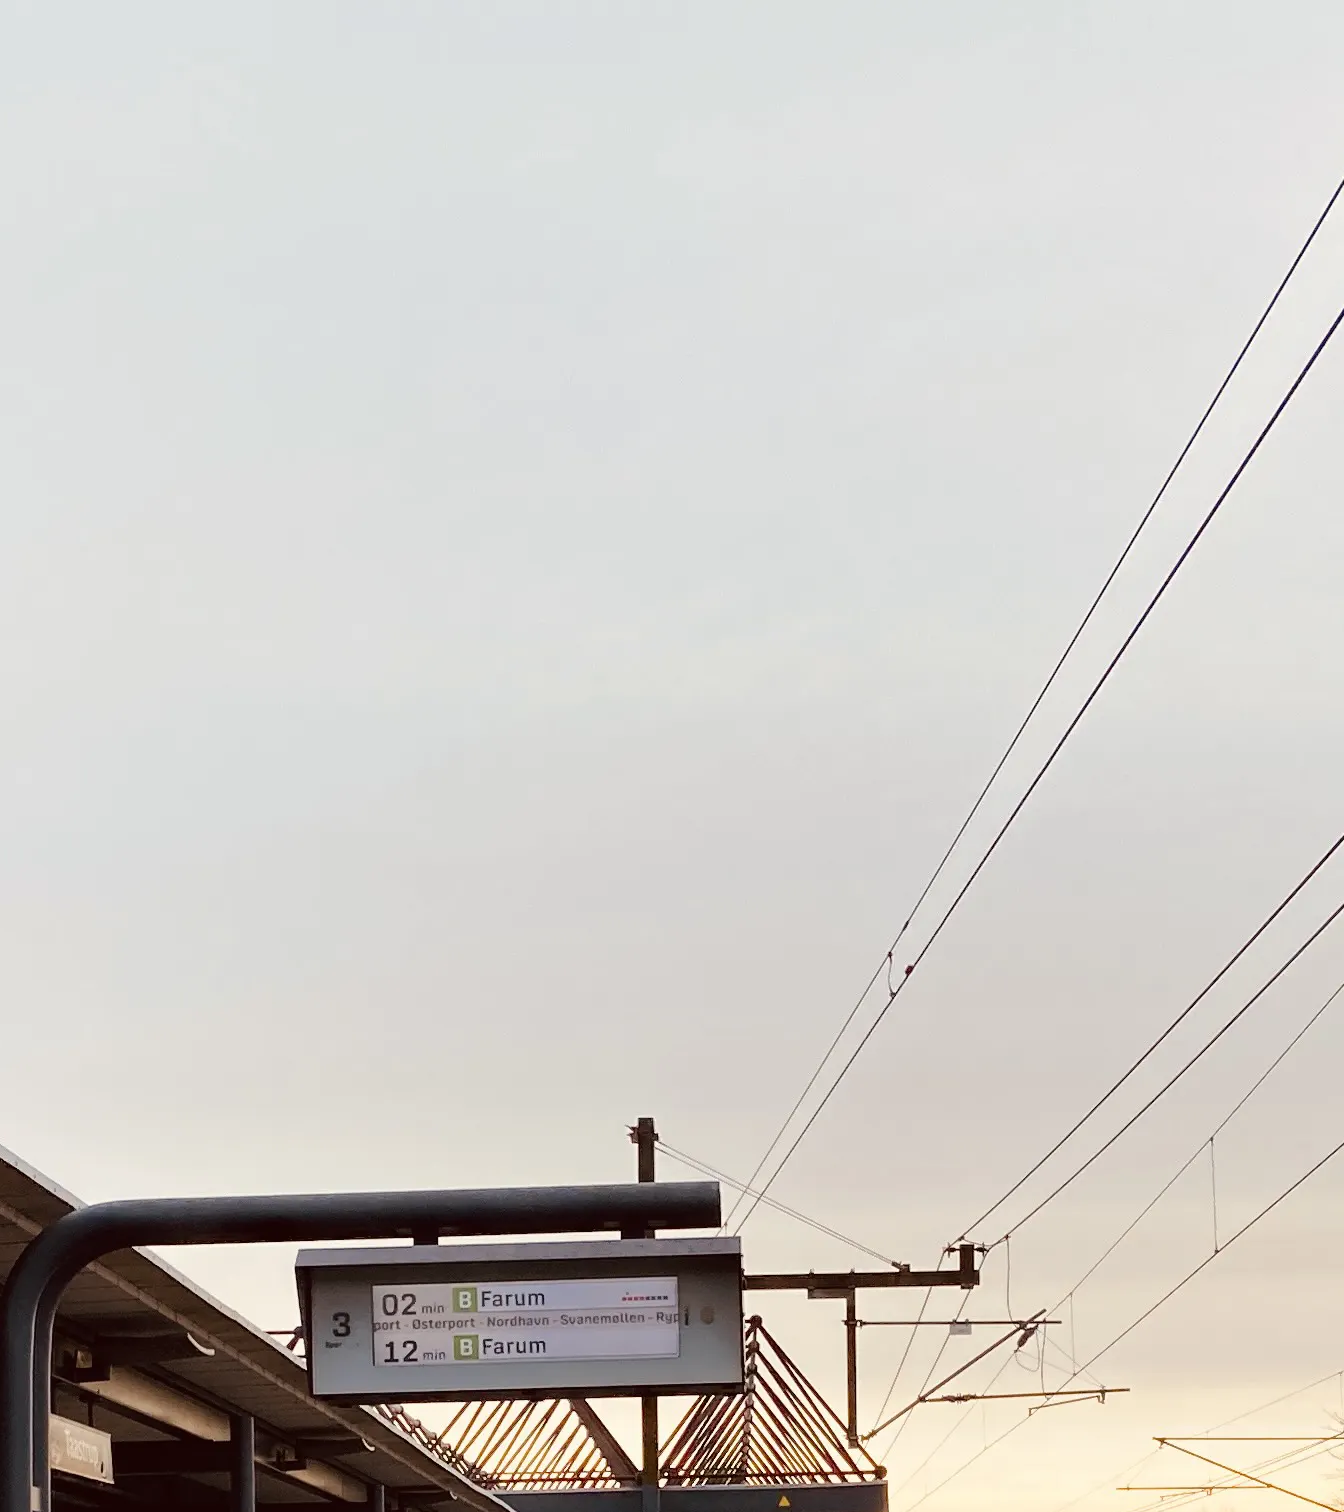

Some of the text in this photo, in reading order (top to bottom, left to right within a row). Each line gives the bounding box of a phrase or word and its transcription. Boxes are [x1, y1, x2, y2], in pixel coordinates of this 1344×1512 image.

[382, 1290, 545, 1316] 02 min B Farum
[331, 1311, 352, 1337] 3
[412, 1318, 476, 1331] Østerport
[487, 1314, 549, 1328] Nordhavn
[560, 1312, 645, 1326] Svanemøllen
[384, 1337, 546, 1363] 12 min B Farum
